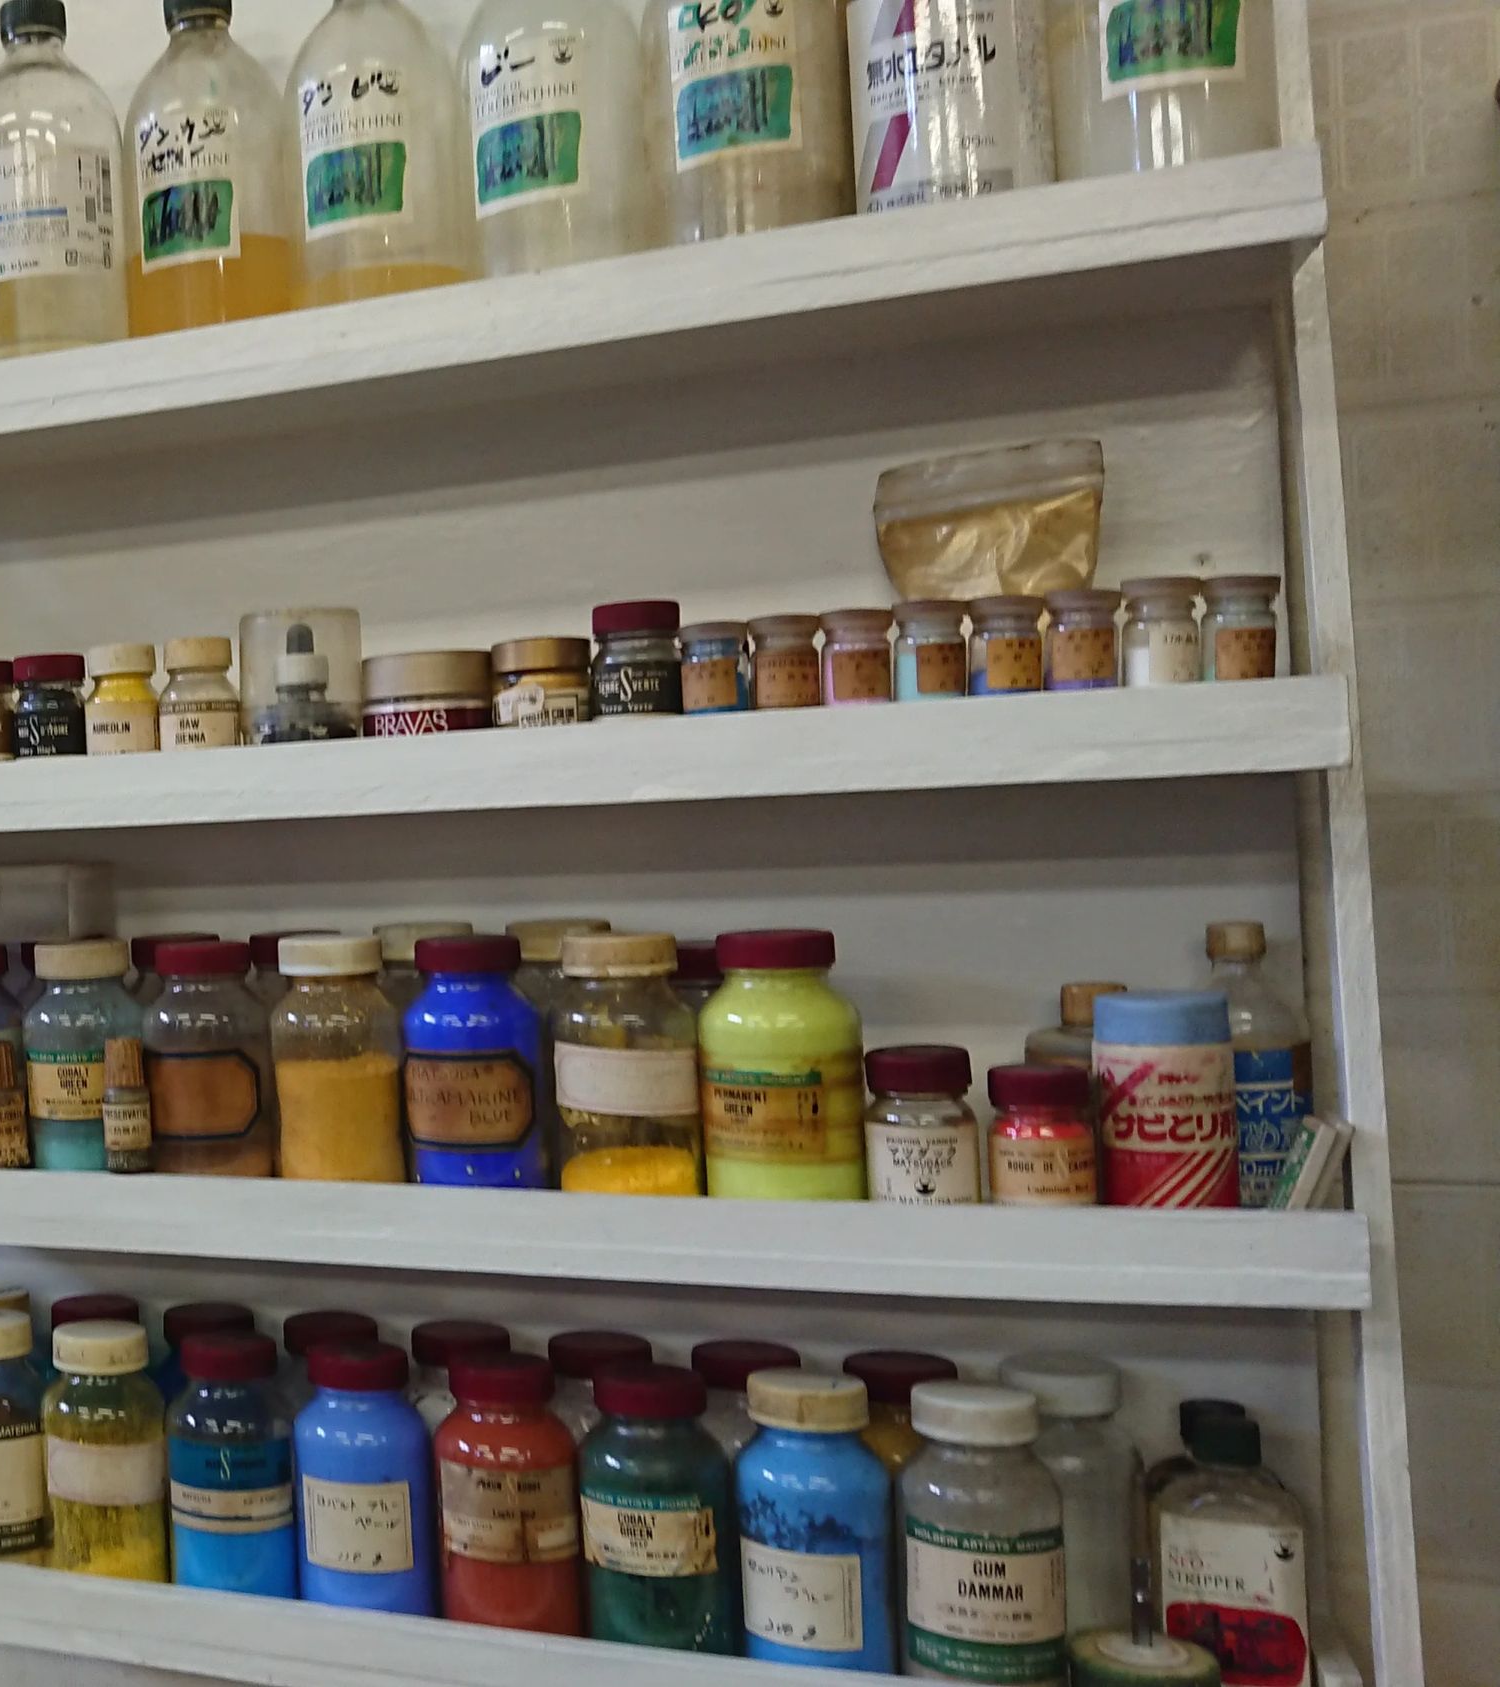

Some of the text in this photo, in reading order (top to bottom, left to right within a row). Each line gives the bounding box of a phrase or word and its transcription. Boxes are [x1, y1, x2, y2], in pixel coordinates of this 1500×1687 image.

[92, 721, 131, 735] AUREOLIN
[374, 709, 450, 738] BRAVAS
[175, 732, 206, 746] SIENNA
[57, 1066, 89, 1079] COBALT
[713, 1087, 767, 1105] PERMANENT
[723, 1101, 753, 1116] GREEN
[617, 1512, 656, 1528] COBALT
[973, 1560, 1007, 1579] GUM
[957, 1578, 1024, 1601] DAMMAR
